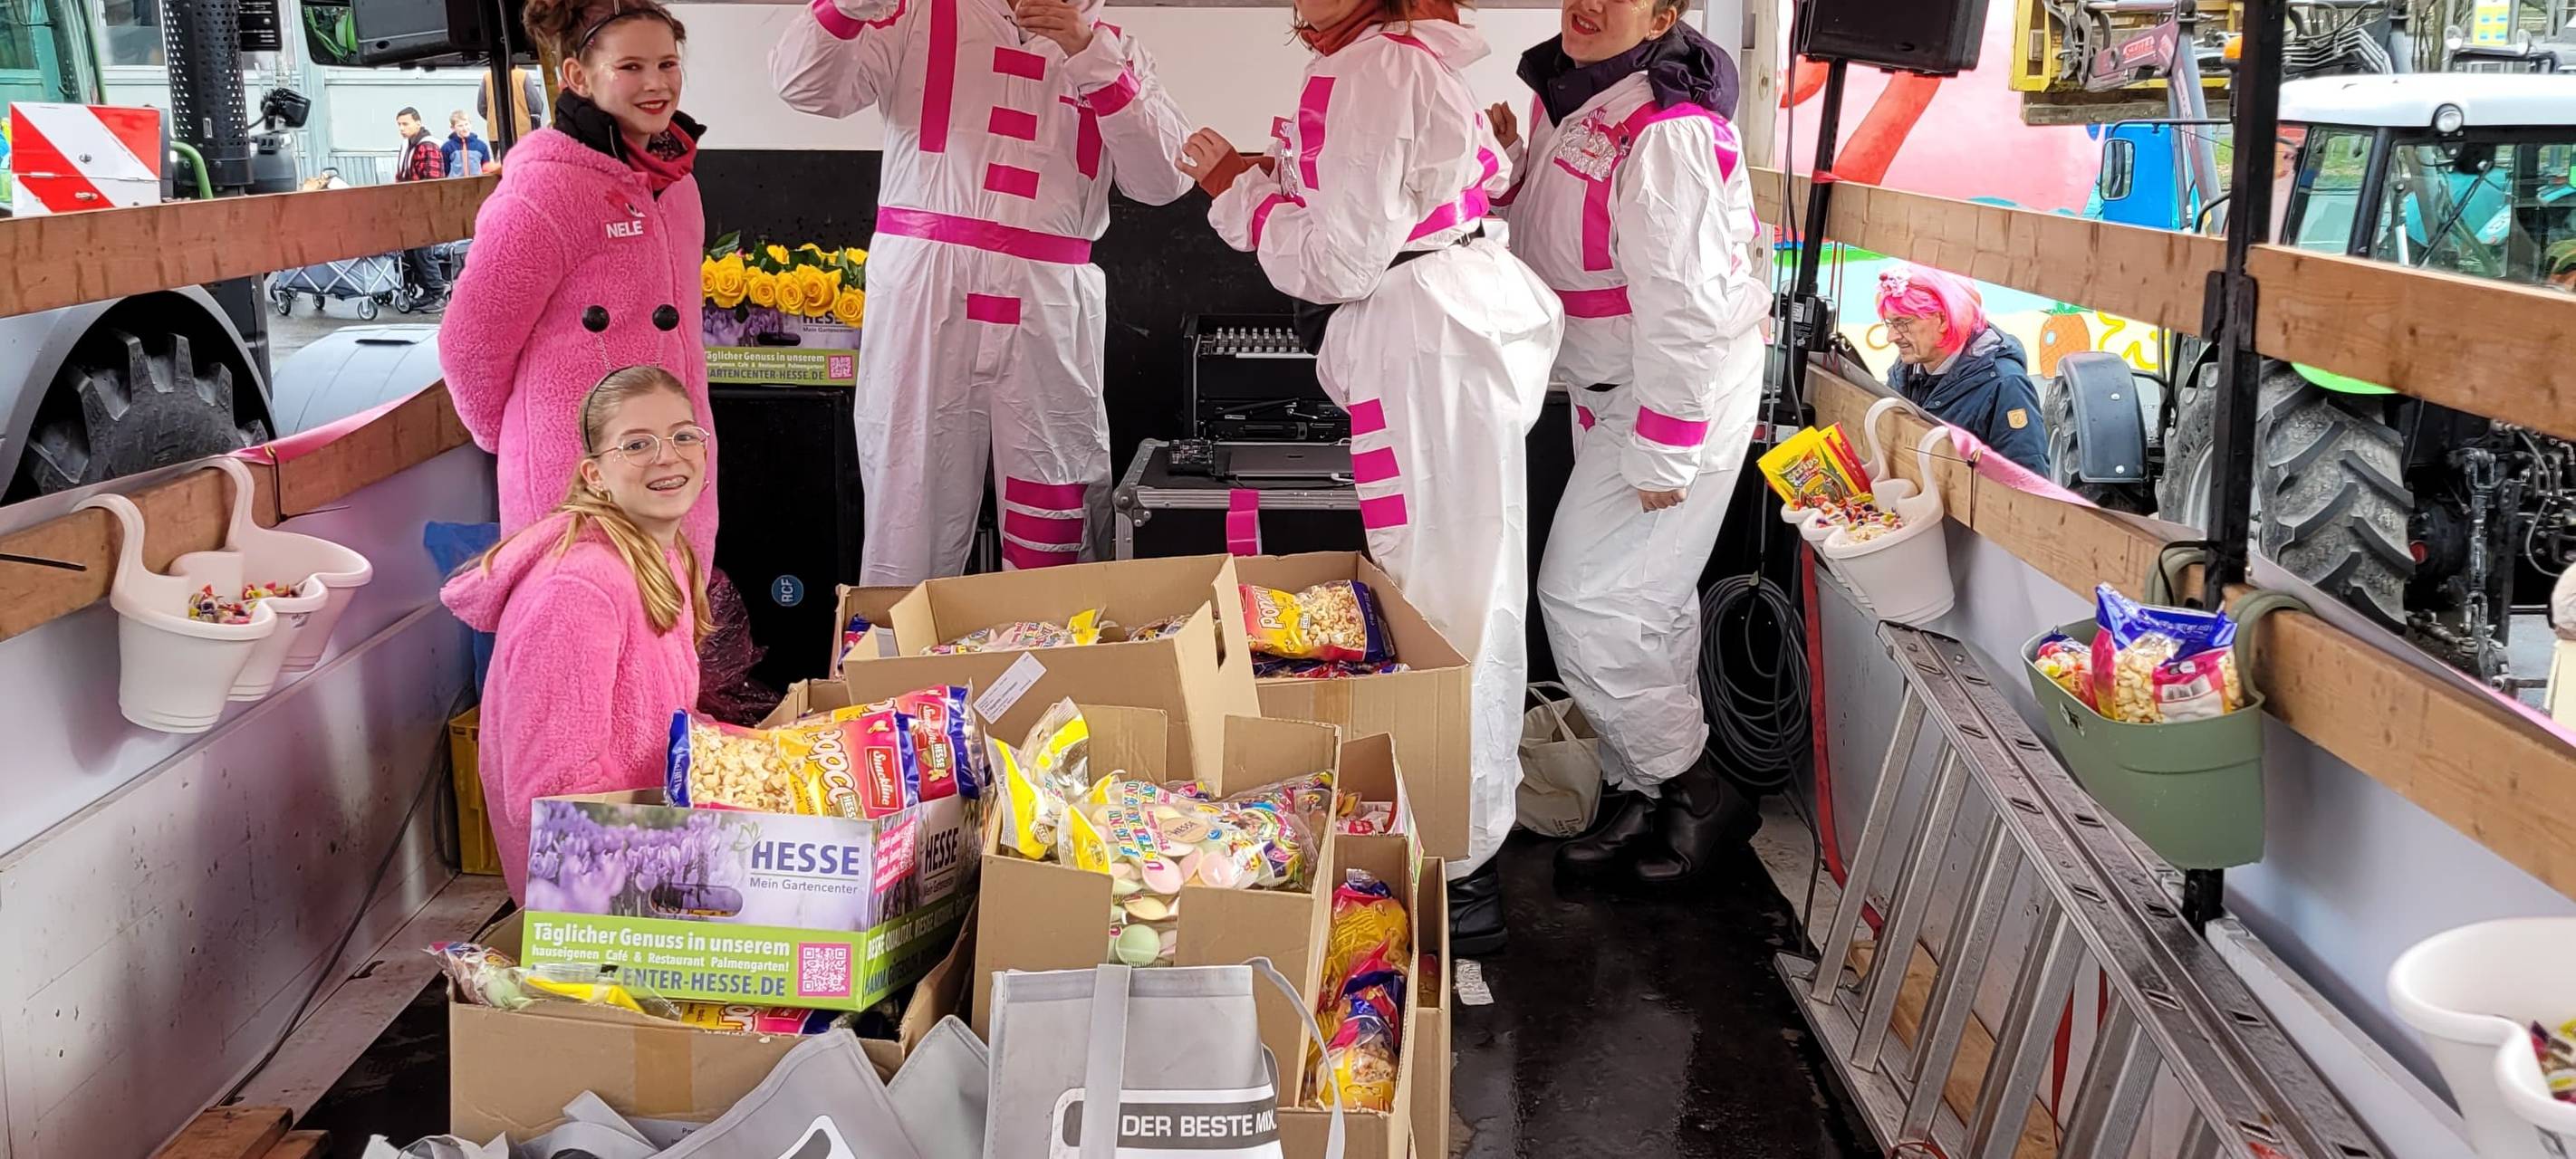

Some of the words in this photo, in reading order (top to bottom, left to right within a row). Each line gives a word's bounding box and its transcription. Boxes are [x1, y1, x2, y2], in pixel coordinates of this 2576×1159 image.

[606, 220, 644, 238] NELE
[744, 351, 775, 362] Genuss
[776, 351, 785, 362] in
[787, 354, 825, 362] unserem
[708, 369, 824, 381] ARTENCENTER-HESSE.DE
[781, 579, 793, 602] RCF
[933, 742, 946, 769] HESSE
[871, 749, 891, 807] Snackline
[842, 794, 857, 819] HESS
[751, 840, 860, 876] HESSE
[925, 827, 959, 875] HESSE
[749, 876, 779, 889] Mein
[782, 878, 859, 895] Gartencenter
[533, 923, 617, 946] Täglicher
[620, 927, 685, 950] Genuss
[687, 932, 706, 951] in
[709, 936, 791, 957] unserem
[531, 944, 600, 961] hauseigenen
[605, 949, 629, 962] Café
[634, 952, 642, 963] &
[648, 953, 705, 968] Restaurant
[710, 956, 790, 974] Palmengarten!
[1121, 1115, 1171, 1137] DER
[1180, 1115, 1254, 1137] BESTE
